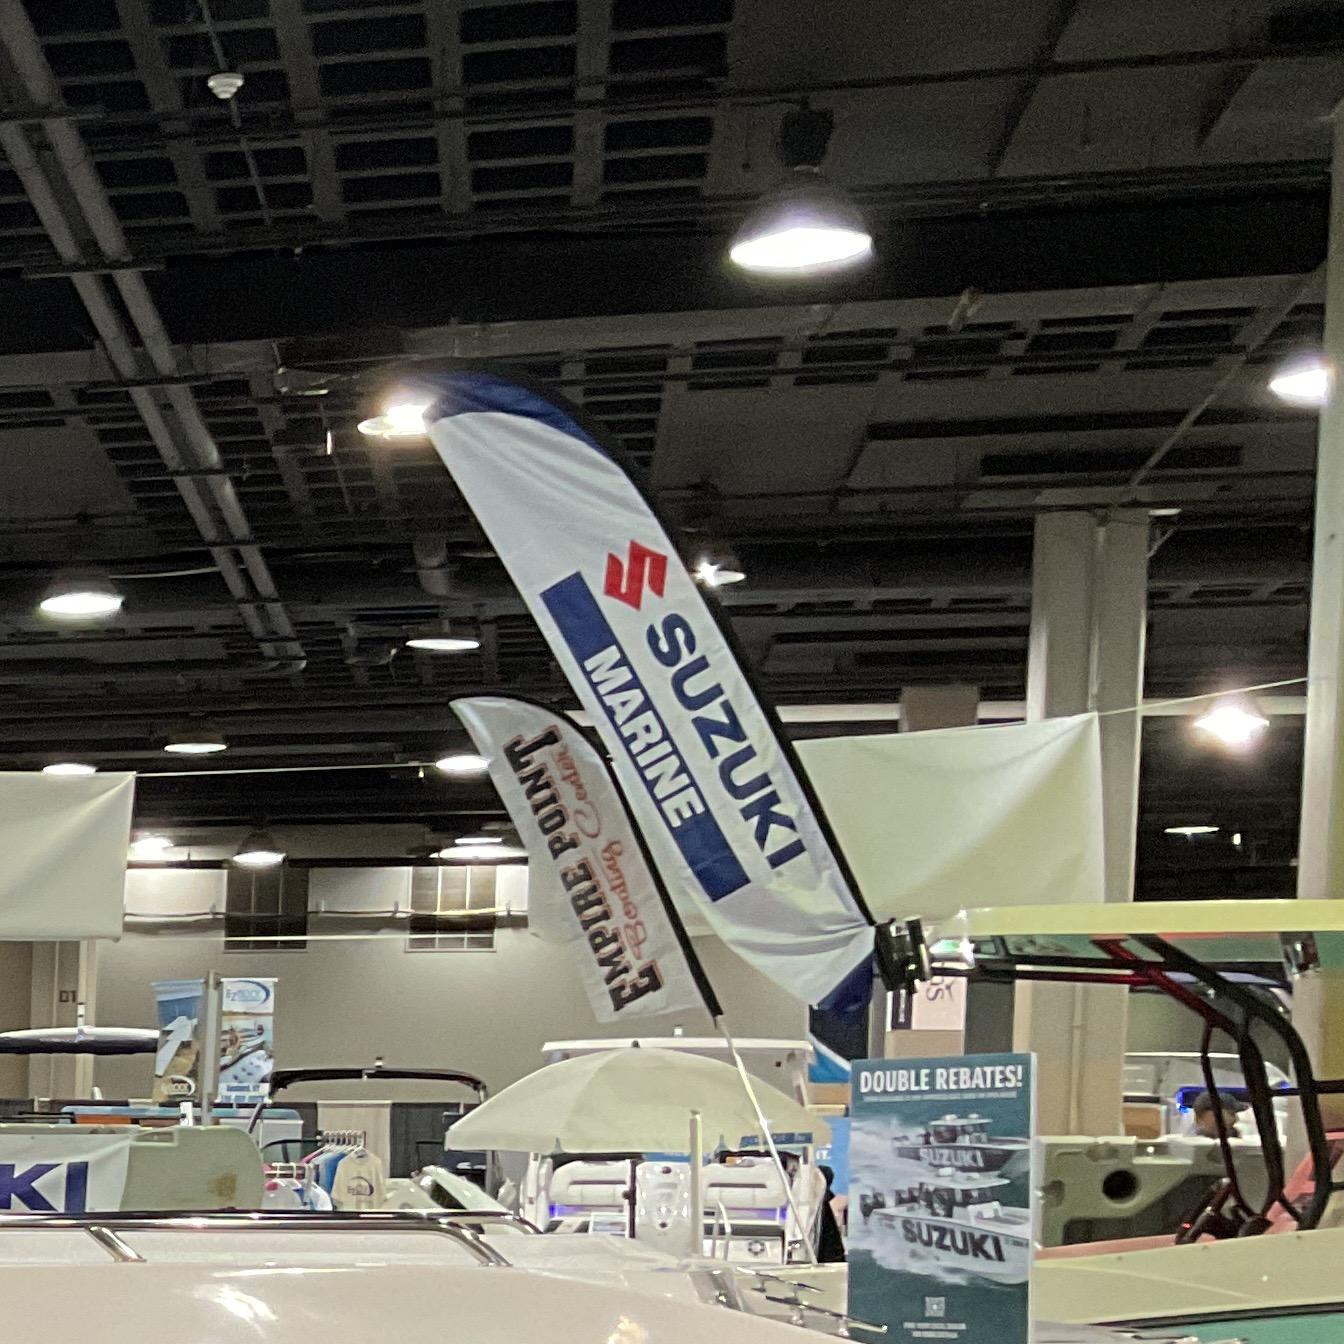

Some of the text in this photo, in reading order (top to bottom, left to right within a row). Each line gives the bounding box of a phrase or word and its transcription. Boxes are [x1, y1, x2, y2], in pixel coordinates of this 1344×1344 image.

[583, 644, 706, 829] MARINE
[646, 613, 808, 871] SUZUKI
[503, 724, 664, 1013] EMPIRE POINT
[859, 1065, 1023, 1093] DOUBLE REBATES!
[919, 1147, 985, 1168] SUZUKI
[901, 1218, 1006, 1262] SUZUKI
